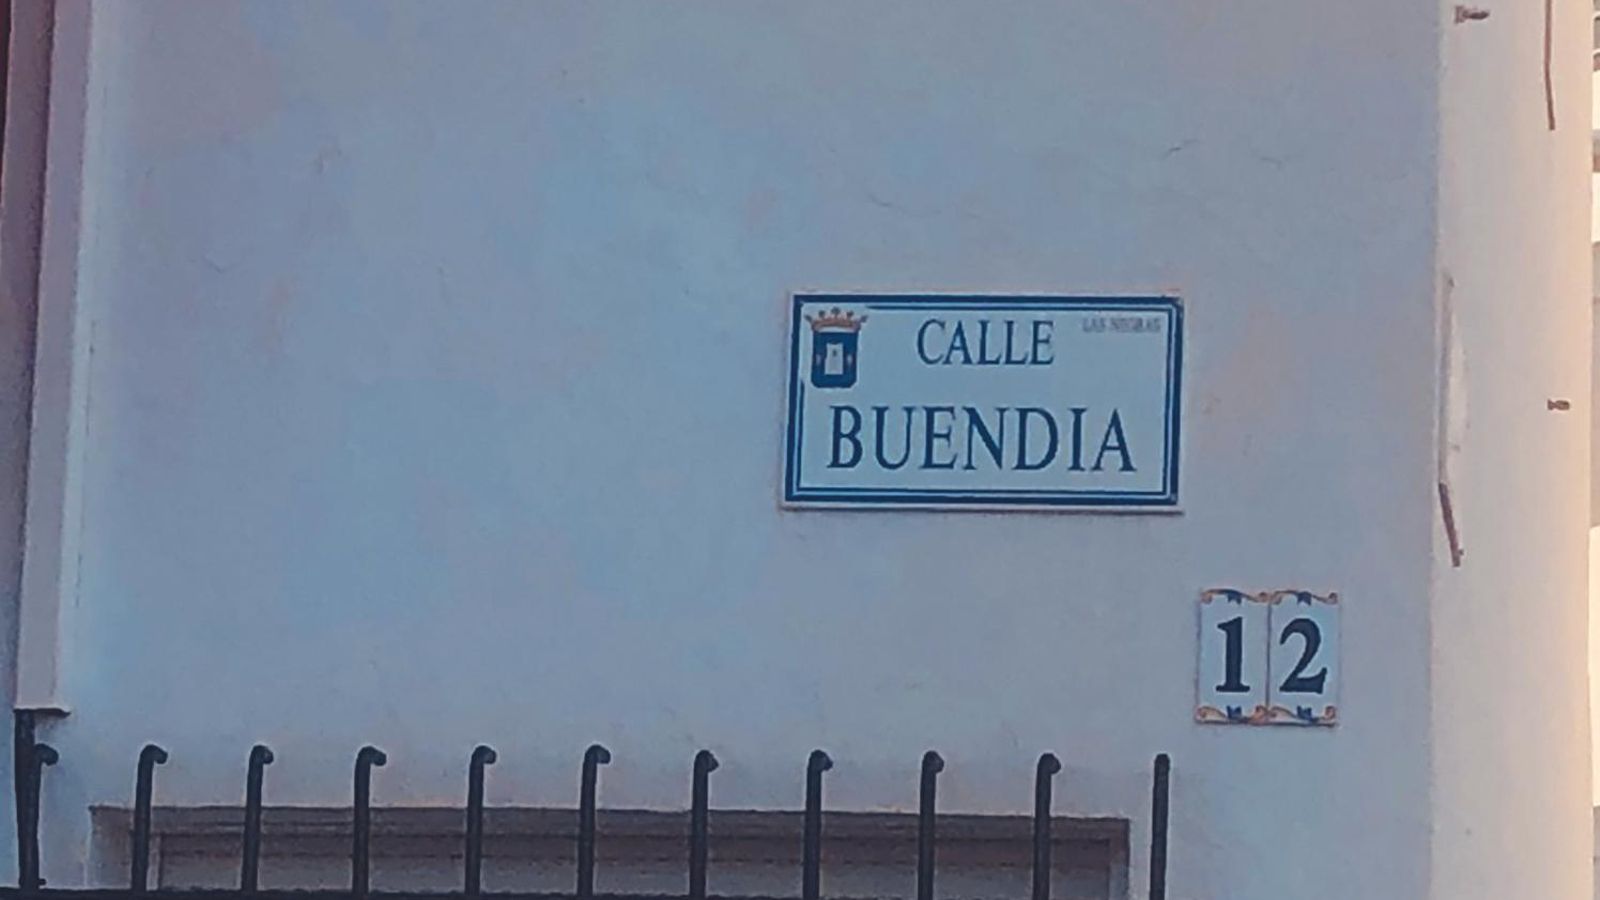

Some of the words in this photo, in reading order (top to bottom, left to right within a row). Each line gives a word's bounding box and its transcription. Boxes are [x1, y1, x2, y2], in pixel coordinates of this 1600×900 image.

[917, 318, 1055, 366] CALLE
[827, 404, 1137, 473] BUENDIA
[1215, 616, 1328, 695] 12
